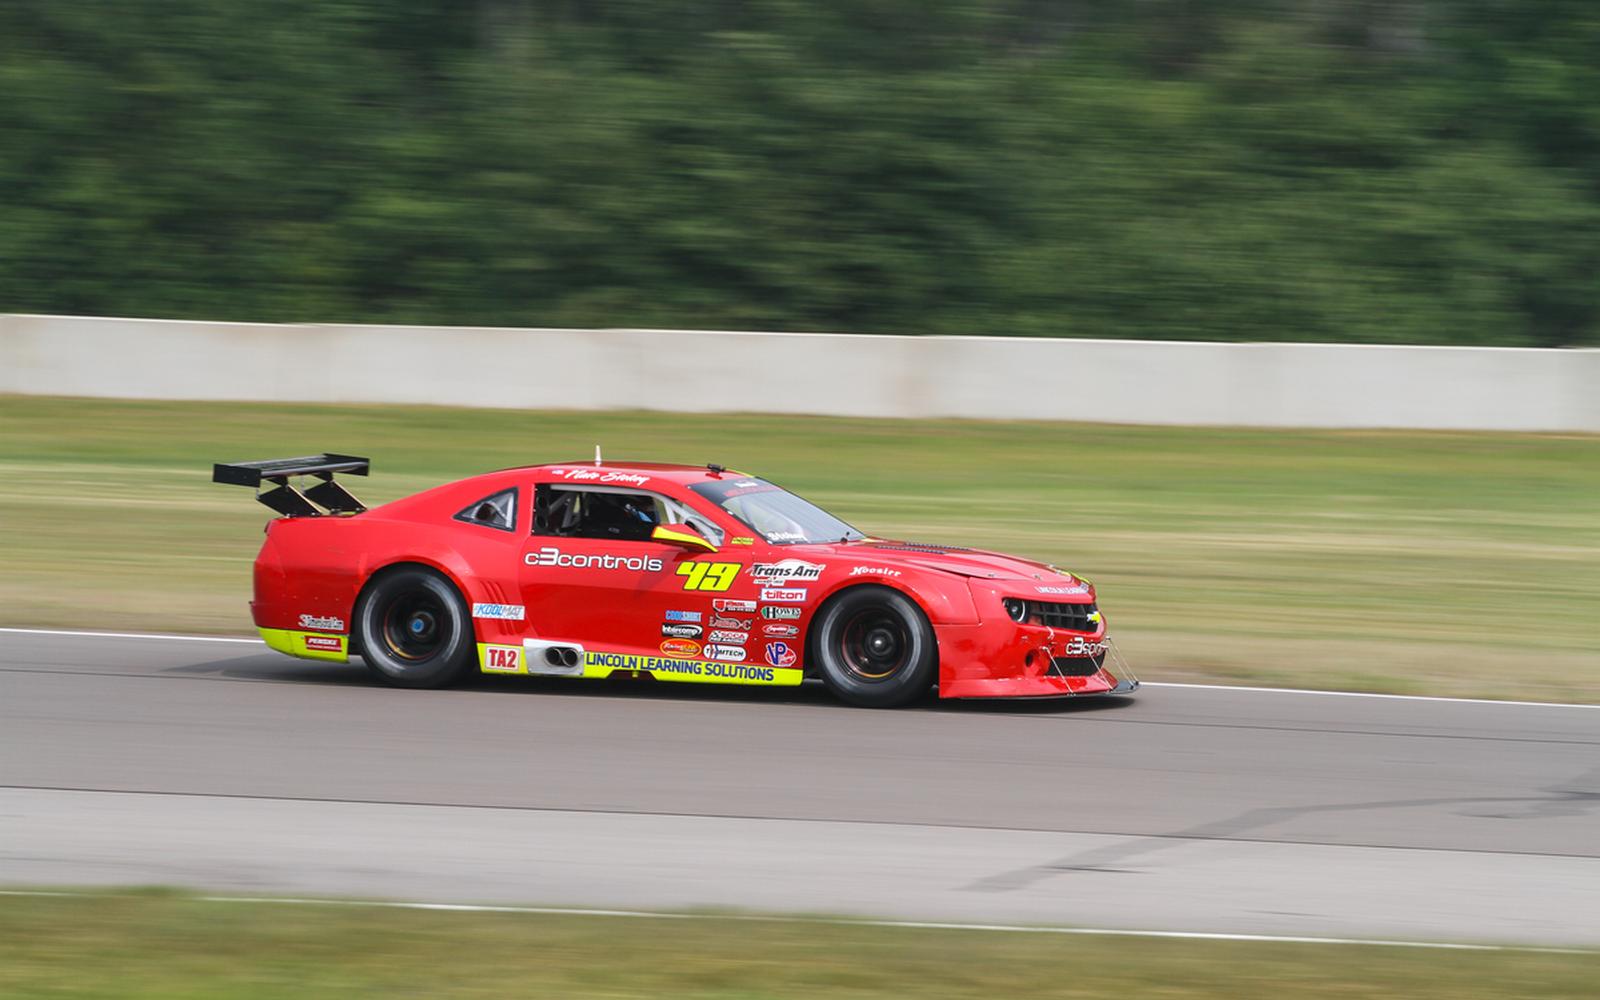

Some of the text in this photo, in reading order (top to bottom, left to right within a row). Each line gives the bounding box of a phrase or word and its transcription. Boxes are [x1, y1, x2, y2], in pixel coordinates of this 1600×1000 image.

[524, 547, 663, 572] c3controls
[752, 564, 820, 577] Trans Am
[676, 561, 743, 592] 49
[764, 590, 803, 599] tilton
[489, 649, 517, 668] TA2
[766, 642, 787, 665] VP
[586, 653, 774, 681] LINCOLN LEARNING SOLUTIONS
